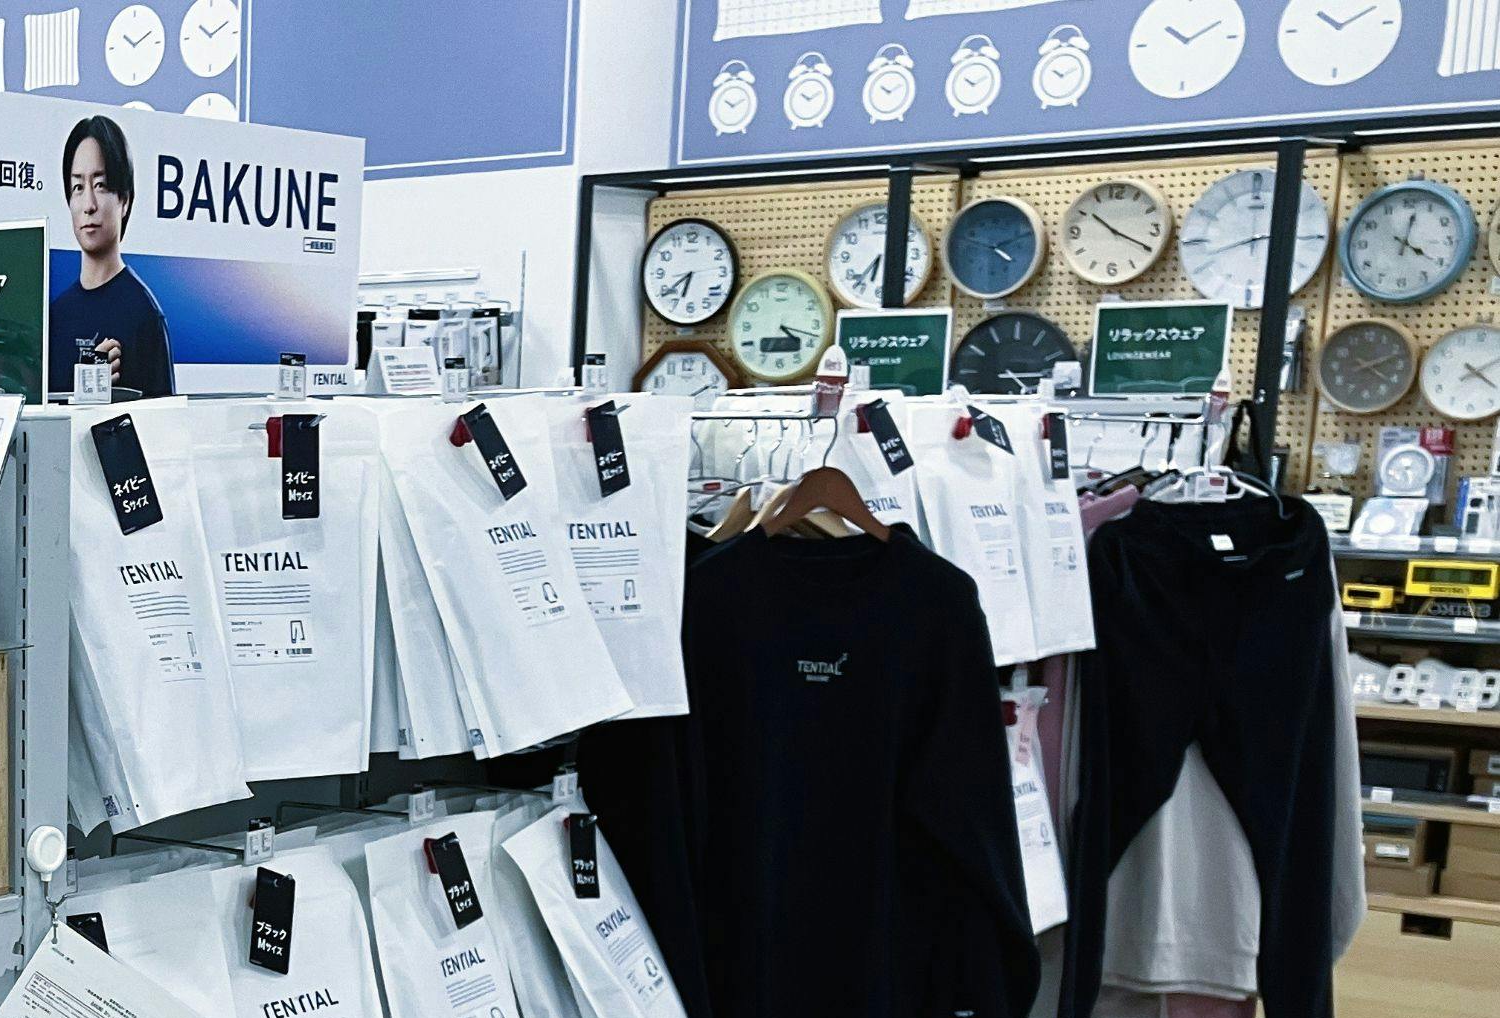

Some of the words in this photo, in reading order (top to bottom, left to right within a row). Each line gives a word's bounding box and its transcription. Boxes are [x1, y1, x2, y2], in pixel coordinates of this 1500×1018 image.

[157, 155, 338, 231] BAKUNE
[848, 334, 929, 348] リラックスウェア
[1109, 327, 1205, 342] リラックスウェア
[314, 373, 347, 386] TENTIAL
[598, 451, 623, 466] ネイビー
[114, 475, 146, 496] ネイビー
[285, 471, 315, 484] ネイビー
[122, 495, 149, 513] Sサイズ
[288, 489, 313, 501] Mサイズ
[866, 496, 902, 513] ENTIAL
[486, 521, 536, 544] TENTIAL
[567, 521, 636, 539] TENTIAL
[221, 552, 308, 572] TENTIAL
[118, 561, 182, 585] TENTIAL
[797, 655, 847, 675] TENTIAL
[574, 859, 594, 871] ブラック
[448, 881, 470, 899] ブラック
[456, 898, 473, 913] Lサイズ
[256, 921, 287, 941] ブラック
[596, 907, 631, 939] TENTIAL
[257, 938, 283, 956] Mサイズ
[441, 947, 485, 977] TENTIAL
